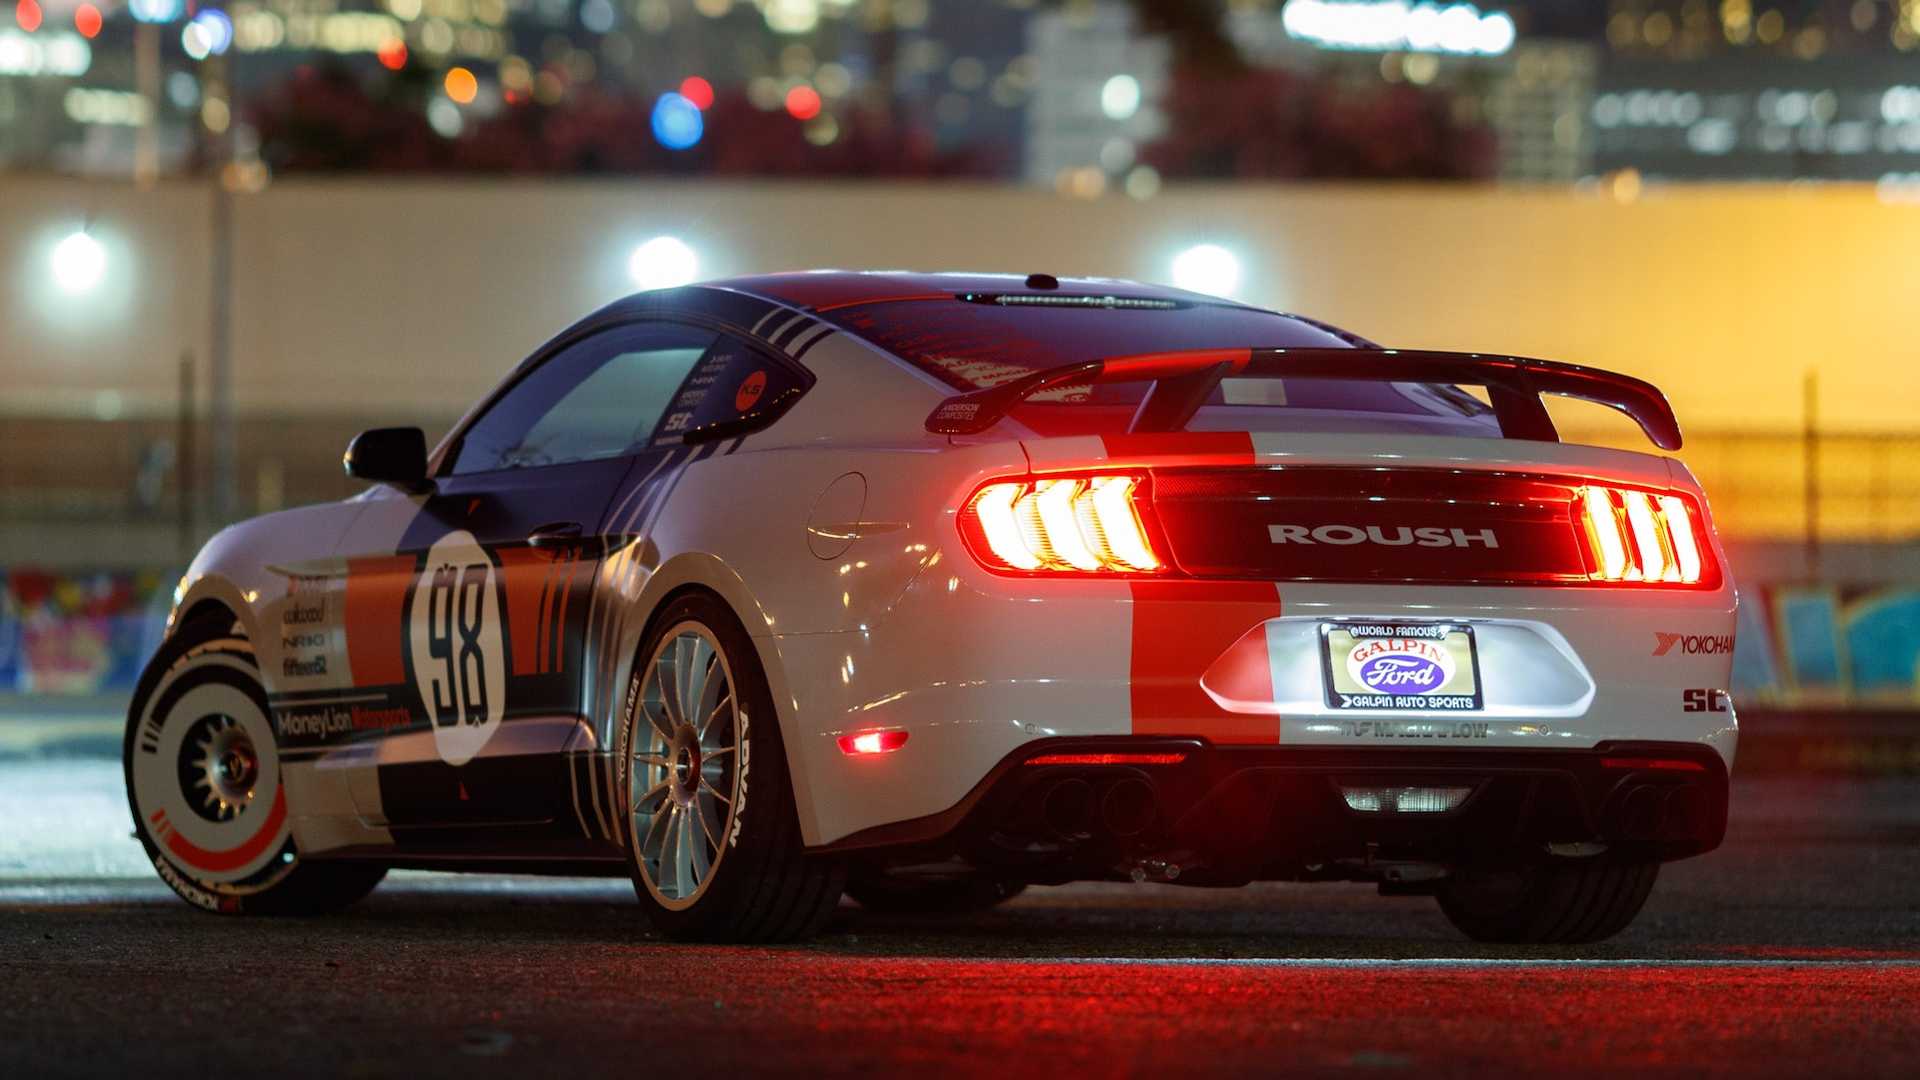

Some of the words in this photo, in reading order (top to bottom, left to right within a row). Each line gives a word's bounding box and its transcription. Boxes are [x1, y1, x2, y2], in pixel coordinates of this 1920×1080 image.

[1267, 524, 1499, 549] ROUSH
[1395, 626, 1438, 638] FAMOUS
[428, 562, 489, 728] 98
[1353, 638, 1444, 662] GALPIN
[1681, 635, 1735, 654] YOKOHAM
[1366, 658, 1435, 687] Ford
[1352, 695, 1394, 708] GALPIN
[1396, 696, 1427, 708] AUTO
[1429, 696, 1474, 709] SPORTS
[729, 709, 750, 848] ADVAN
